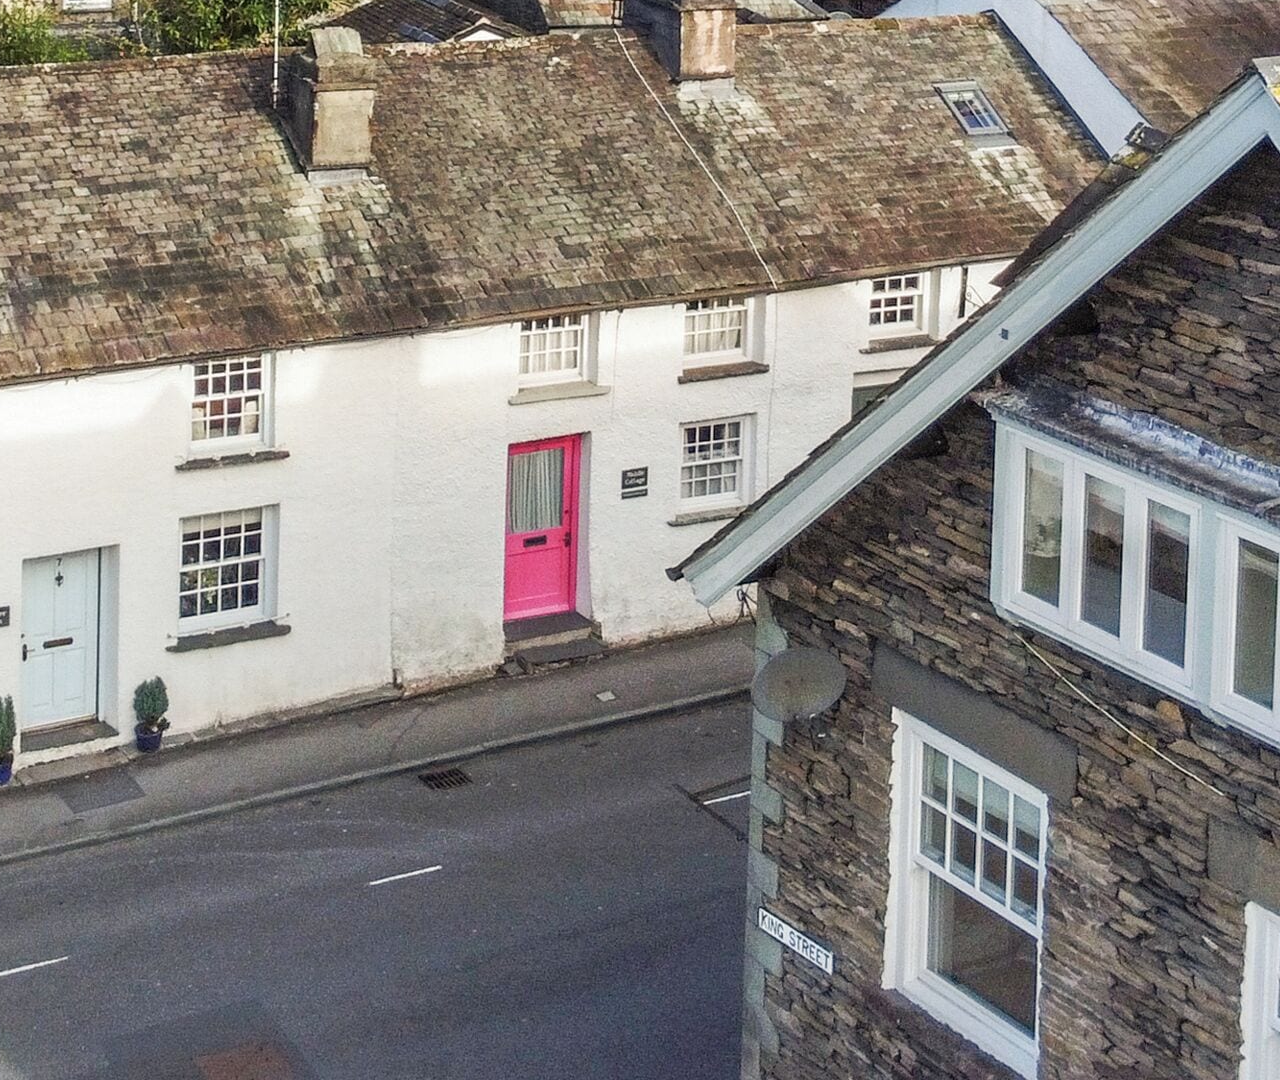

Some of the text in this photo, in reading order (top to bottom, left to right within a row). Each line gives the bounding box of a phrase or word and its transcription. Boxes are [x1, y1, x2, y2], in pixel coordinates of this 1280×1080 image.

[56, 557, 63, 567] 7
[761, 911, 830, 969] KING STREET
